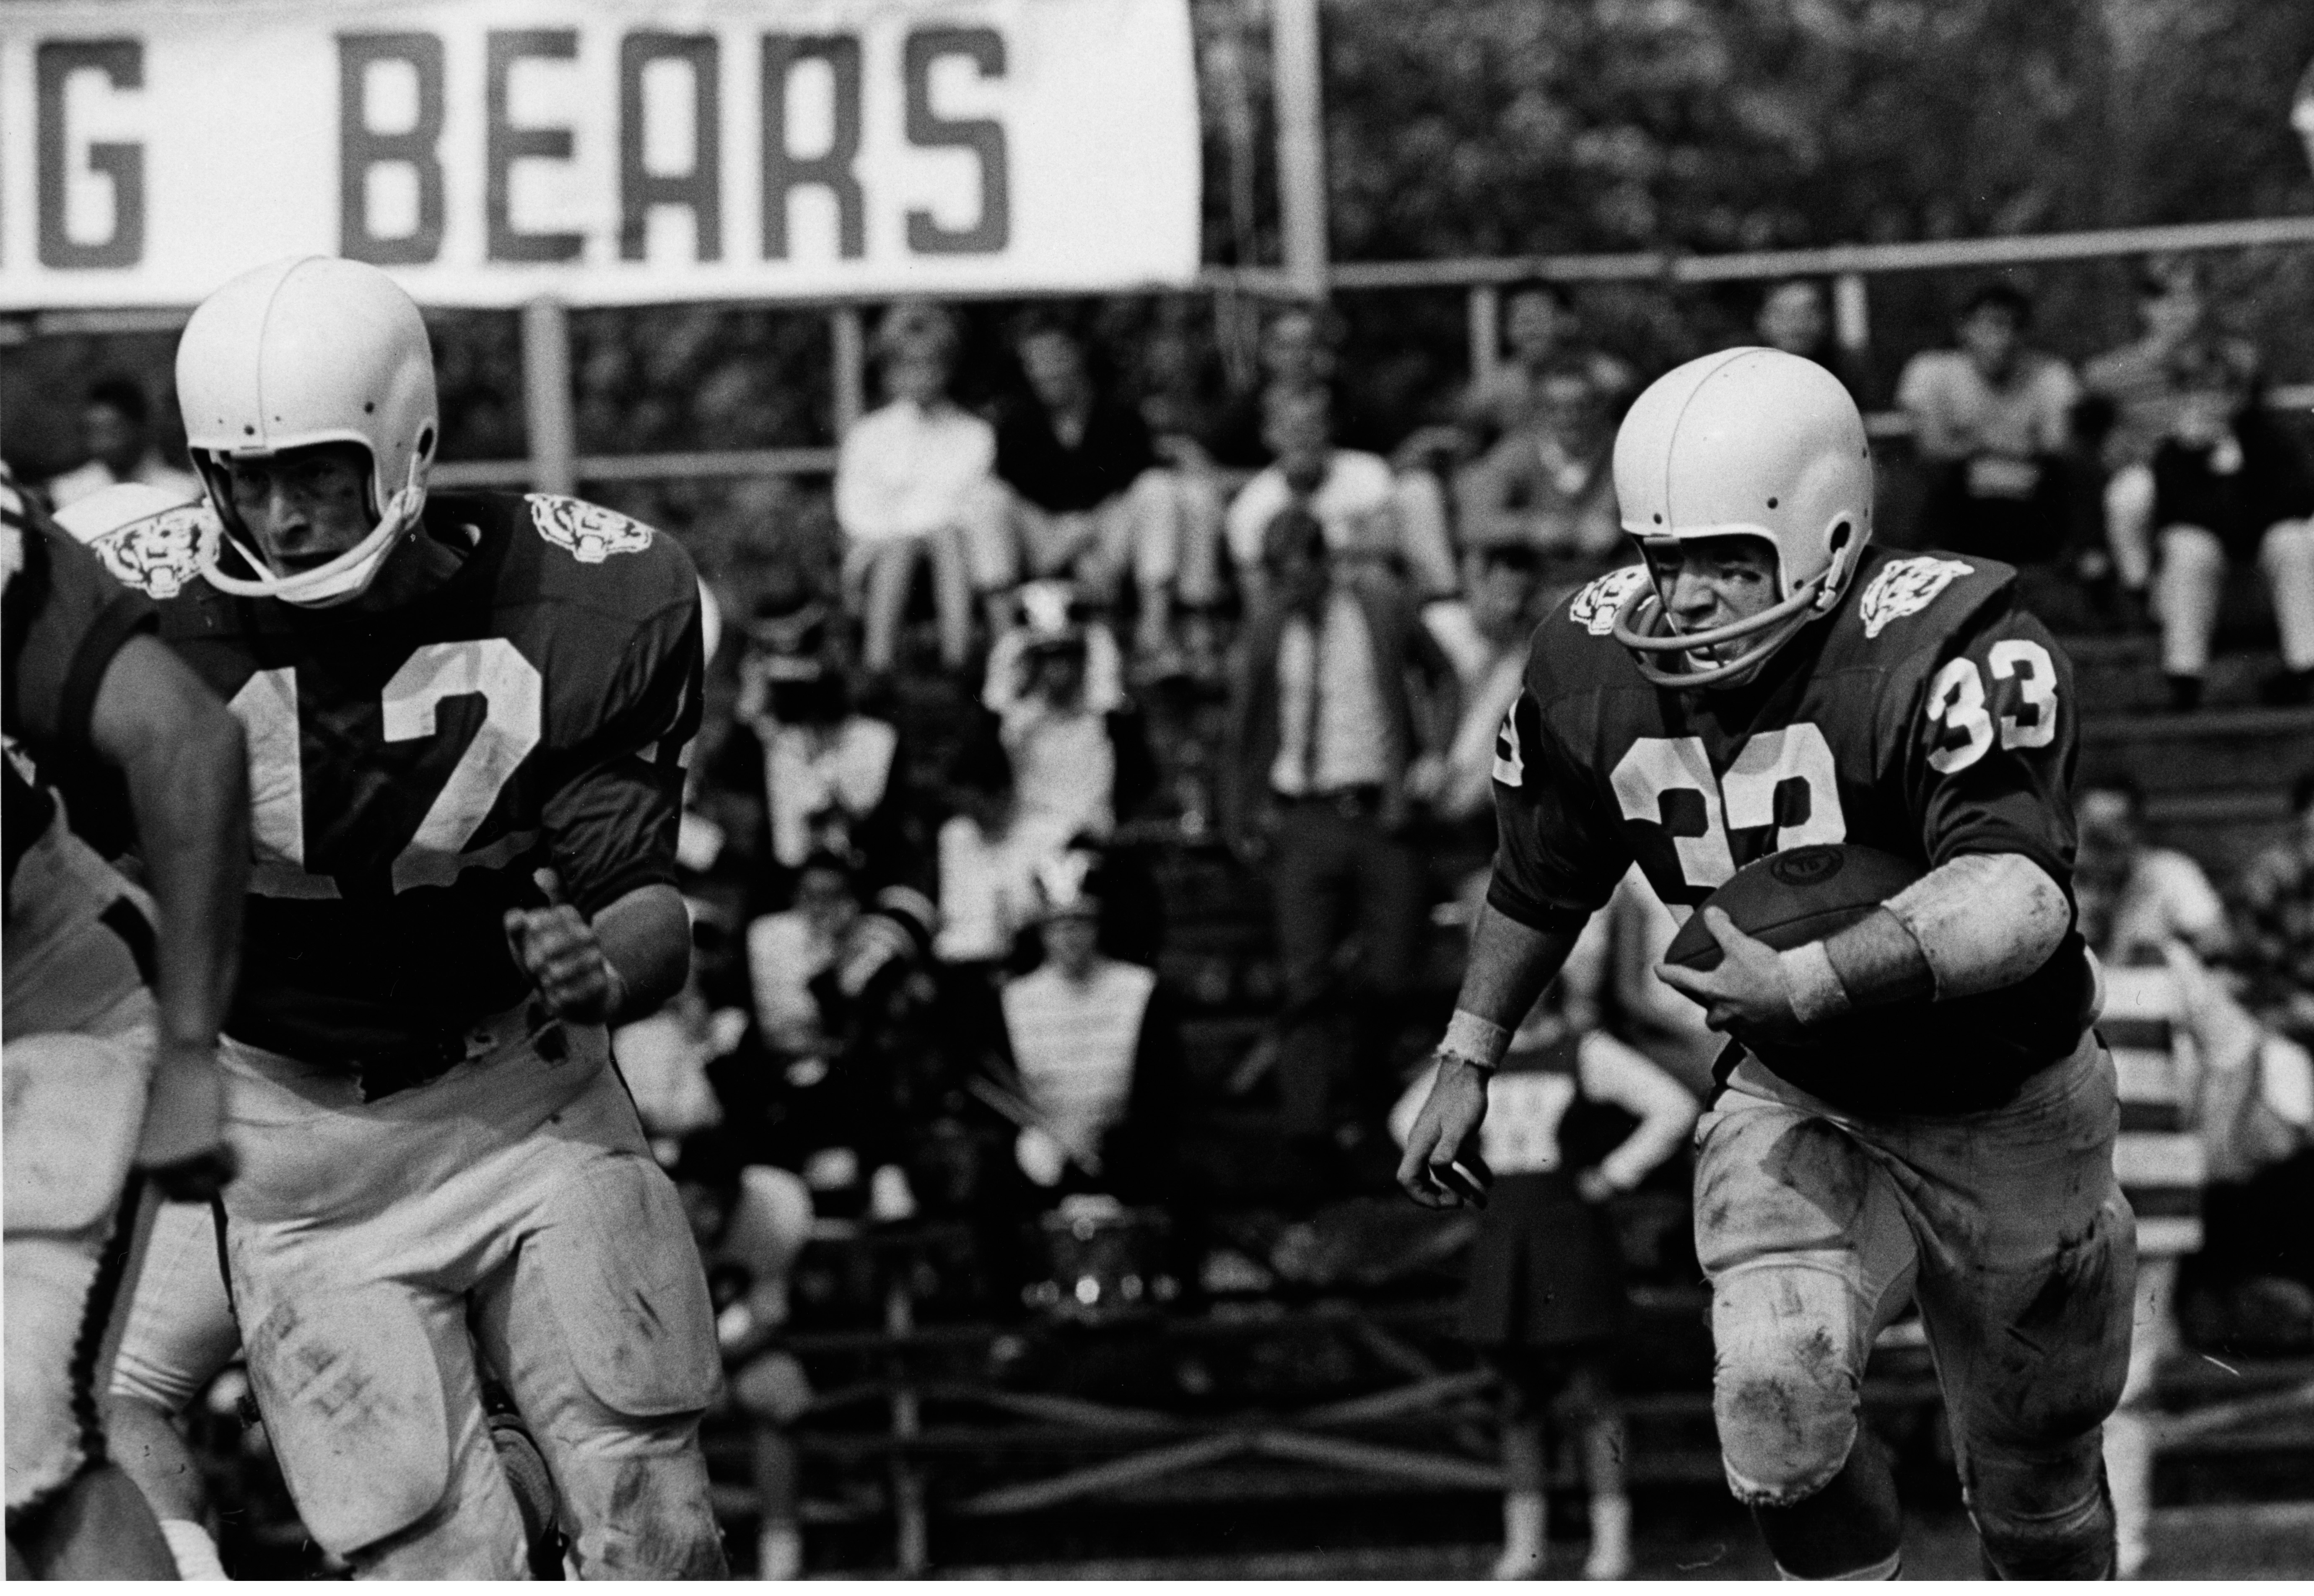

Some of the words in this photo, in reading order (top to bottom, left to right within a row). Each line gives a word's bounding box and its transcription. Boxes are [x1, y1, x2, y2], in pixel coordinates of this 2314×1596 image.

[36, 34, 145, 269] G
[337, 27, 1009, 264] BEARS
[226, 638, 542, 899] 12
[1927, 639, 2058, 775] 33
